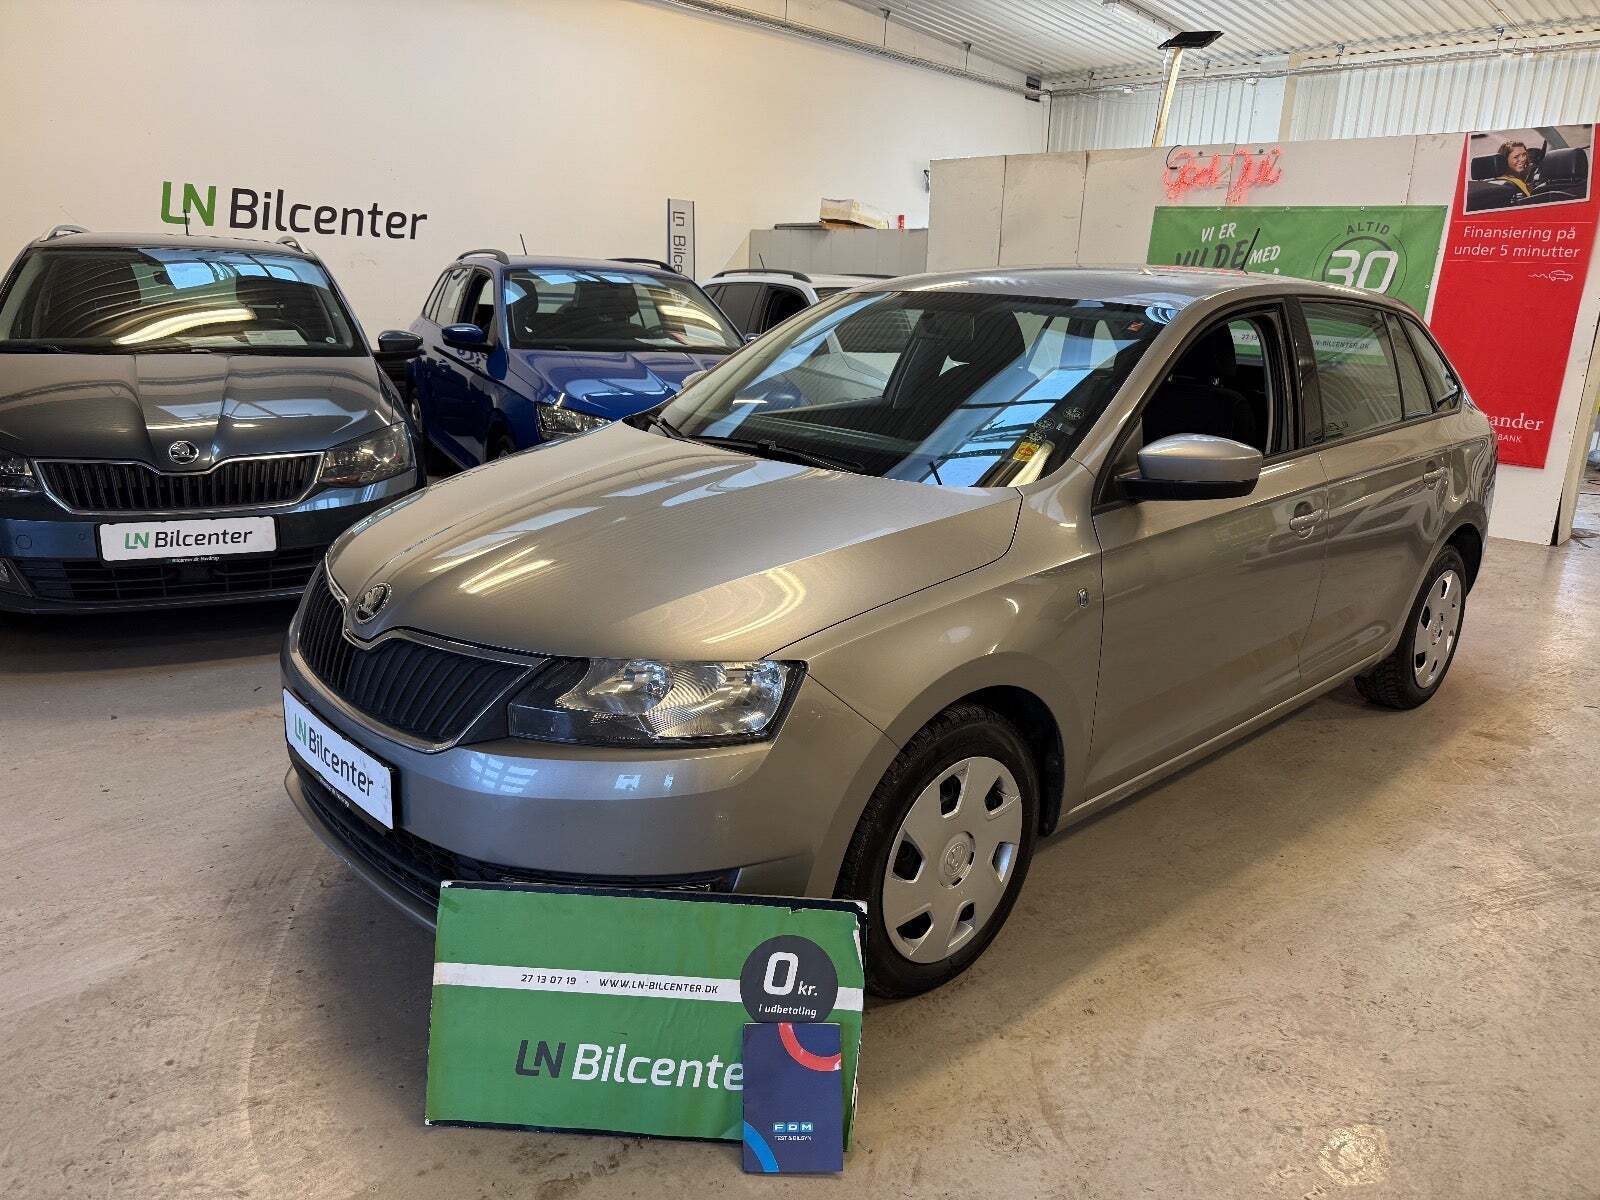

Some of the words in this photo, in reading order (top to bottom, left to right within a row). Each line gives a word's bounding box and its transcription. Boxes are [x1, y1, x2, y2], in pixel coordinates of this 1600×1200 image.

[160, 180, 217, 227] LN
[229, 187, 428, 240] Bilcenter
[1201, 226, 1215, 243] VI
[1218, 222, 1237, 240] ER
[1346, 221, 1391, 236] ALTID
[1463, 225, 1552, 242] Finansiering
[1556, 226, 1577, 242] på
[673, 235, 687, 274] Bilce
[1248, 245, 1281, 265] MED
[1454, 243, 1496, 256] under
[1500, 244, 1509, 256] 5
[1512, 244, 1581, 258] minutter
[1328, 249, 1399, 294] 30
[1497, 433, 1521, 443] BANK
[124, 531, 149, 550] LN
[154, 529, 253, 549] Bilcenter
[294, 712, 307, 746] LN
[308, 726, 374, 797] Bilcenter
[763, 951, 799, 996] 0
[797, 980, 818, 996] kr.
[520, 974, 533, 983] 27
[536, 975, 547, 984] 13
[549, 975, 563, 985] 07
[565, 976, 577, 985] 19
[599, 978, 719, 995] WWW.LN-BILCENTER.DK
[764, 1004, 817, 1019] udbetaling
[515, 1039, 567, 1079] LN
[571, 1043, 744, 1092] Bilcente
[774, 1123, 813, 1131] FDM
